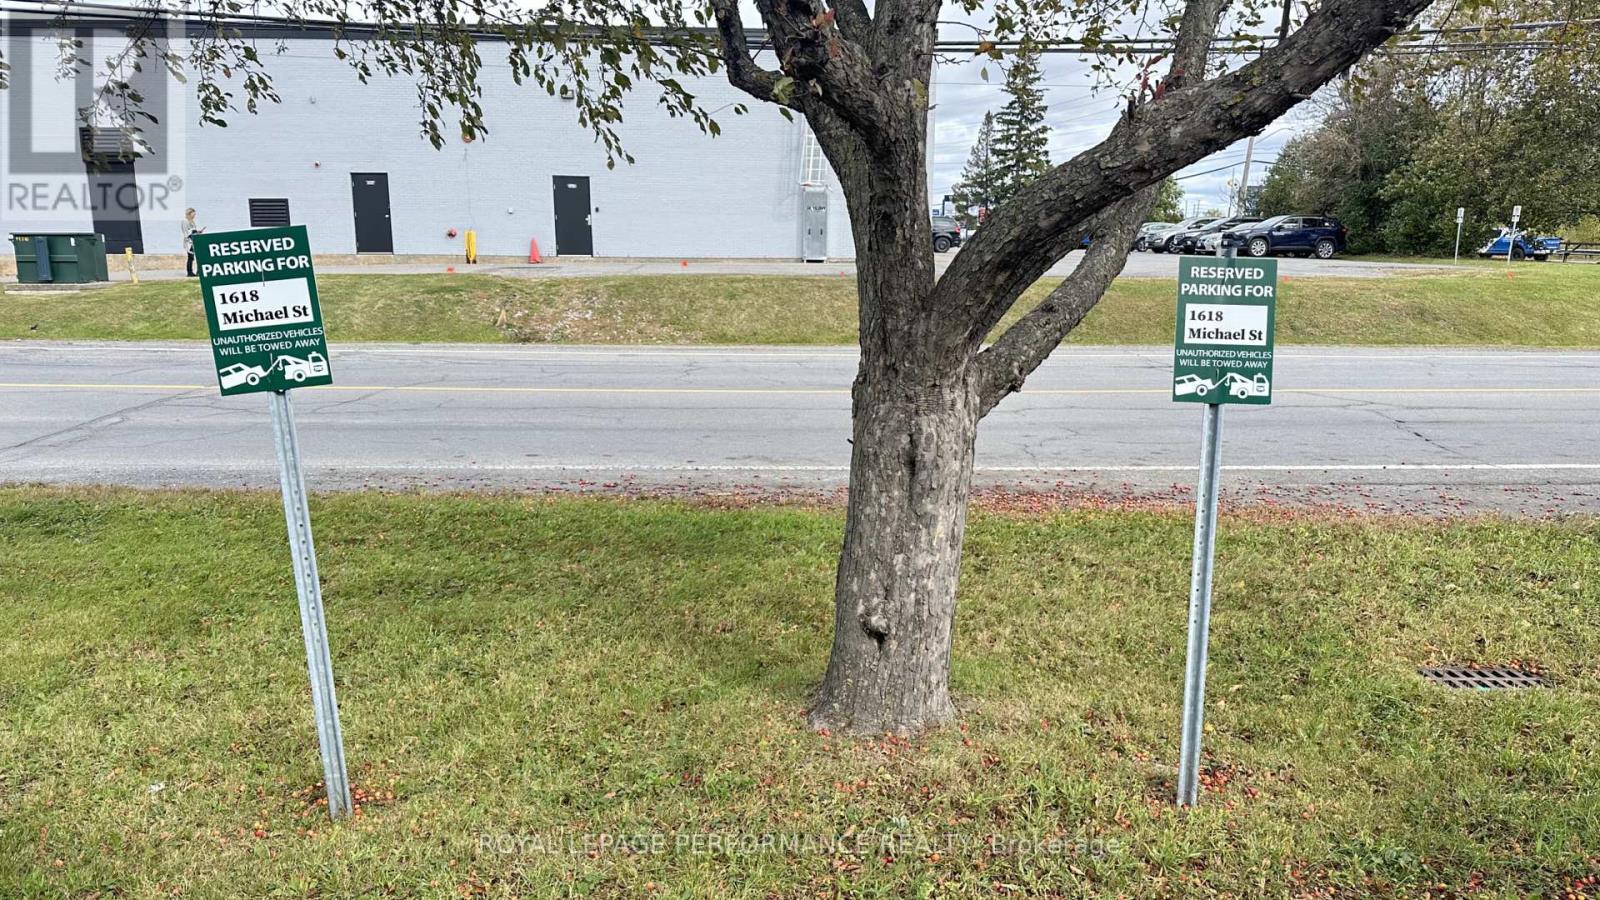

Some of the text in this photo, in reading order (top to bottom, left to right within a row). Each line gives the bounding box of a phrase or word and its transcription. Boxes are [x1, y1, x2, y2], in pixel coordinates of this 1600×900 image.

[208, 237, 295, 257] RESERVED
[202, 255, 310, 277] PARKING FOR
[1191, 266, 1264, 280] RESERVED
[219, 290, 260, 305] 1618
[1181, 284, 1273, 297] PARKING FOR
[222, 305, 309, 325] Michael St
[1190, 310, 1224, 321] 1618
[213, 327, 323, 346] UNAUTHORIZED VEHICLES
[1188, 328, 1263, 341] Michael St
[219, 338, 320, 356] WILL BE TOWED AWAY
[1176, 349, 1272, 359] UNAUTHORIZED VEHICLES
[1179, 358, 1268, 369] WILL BE TOWED AWAY
